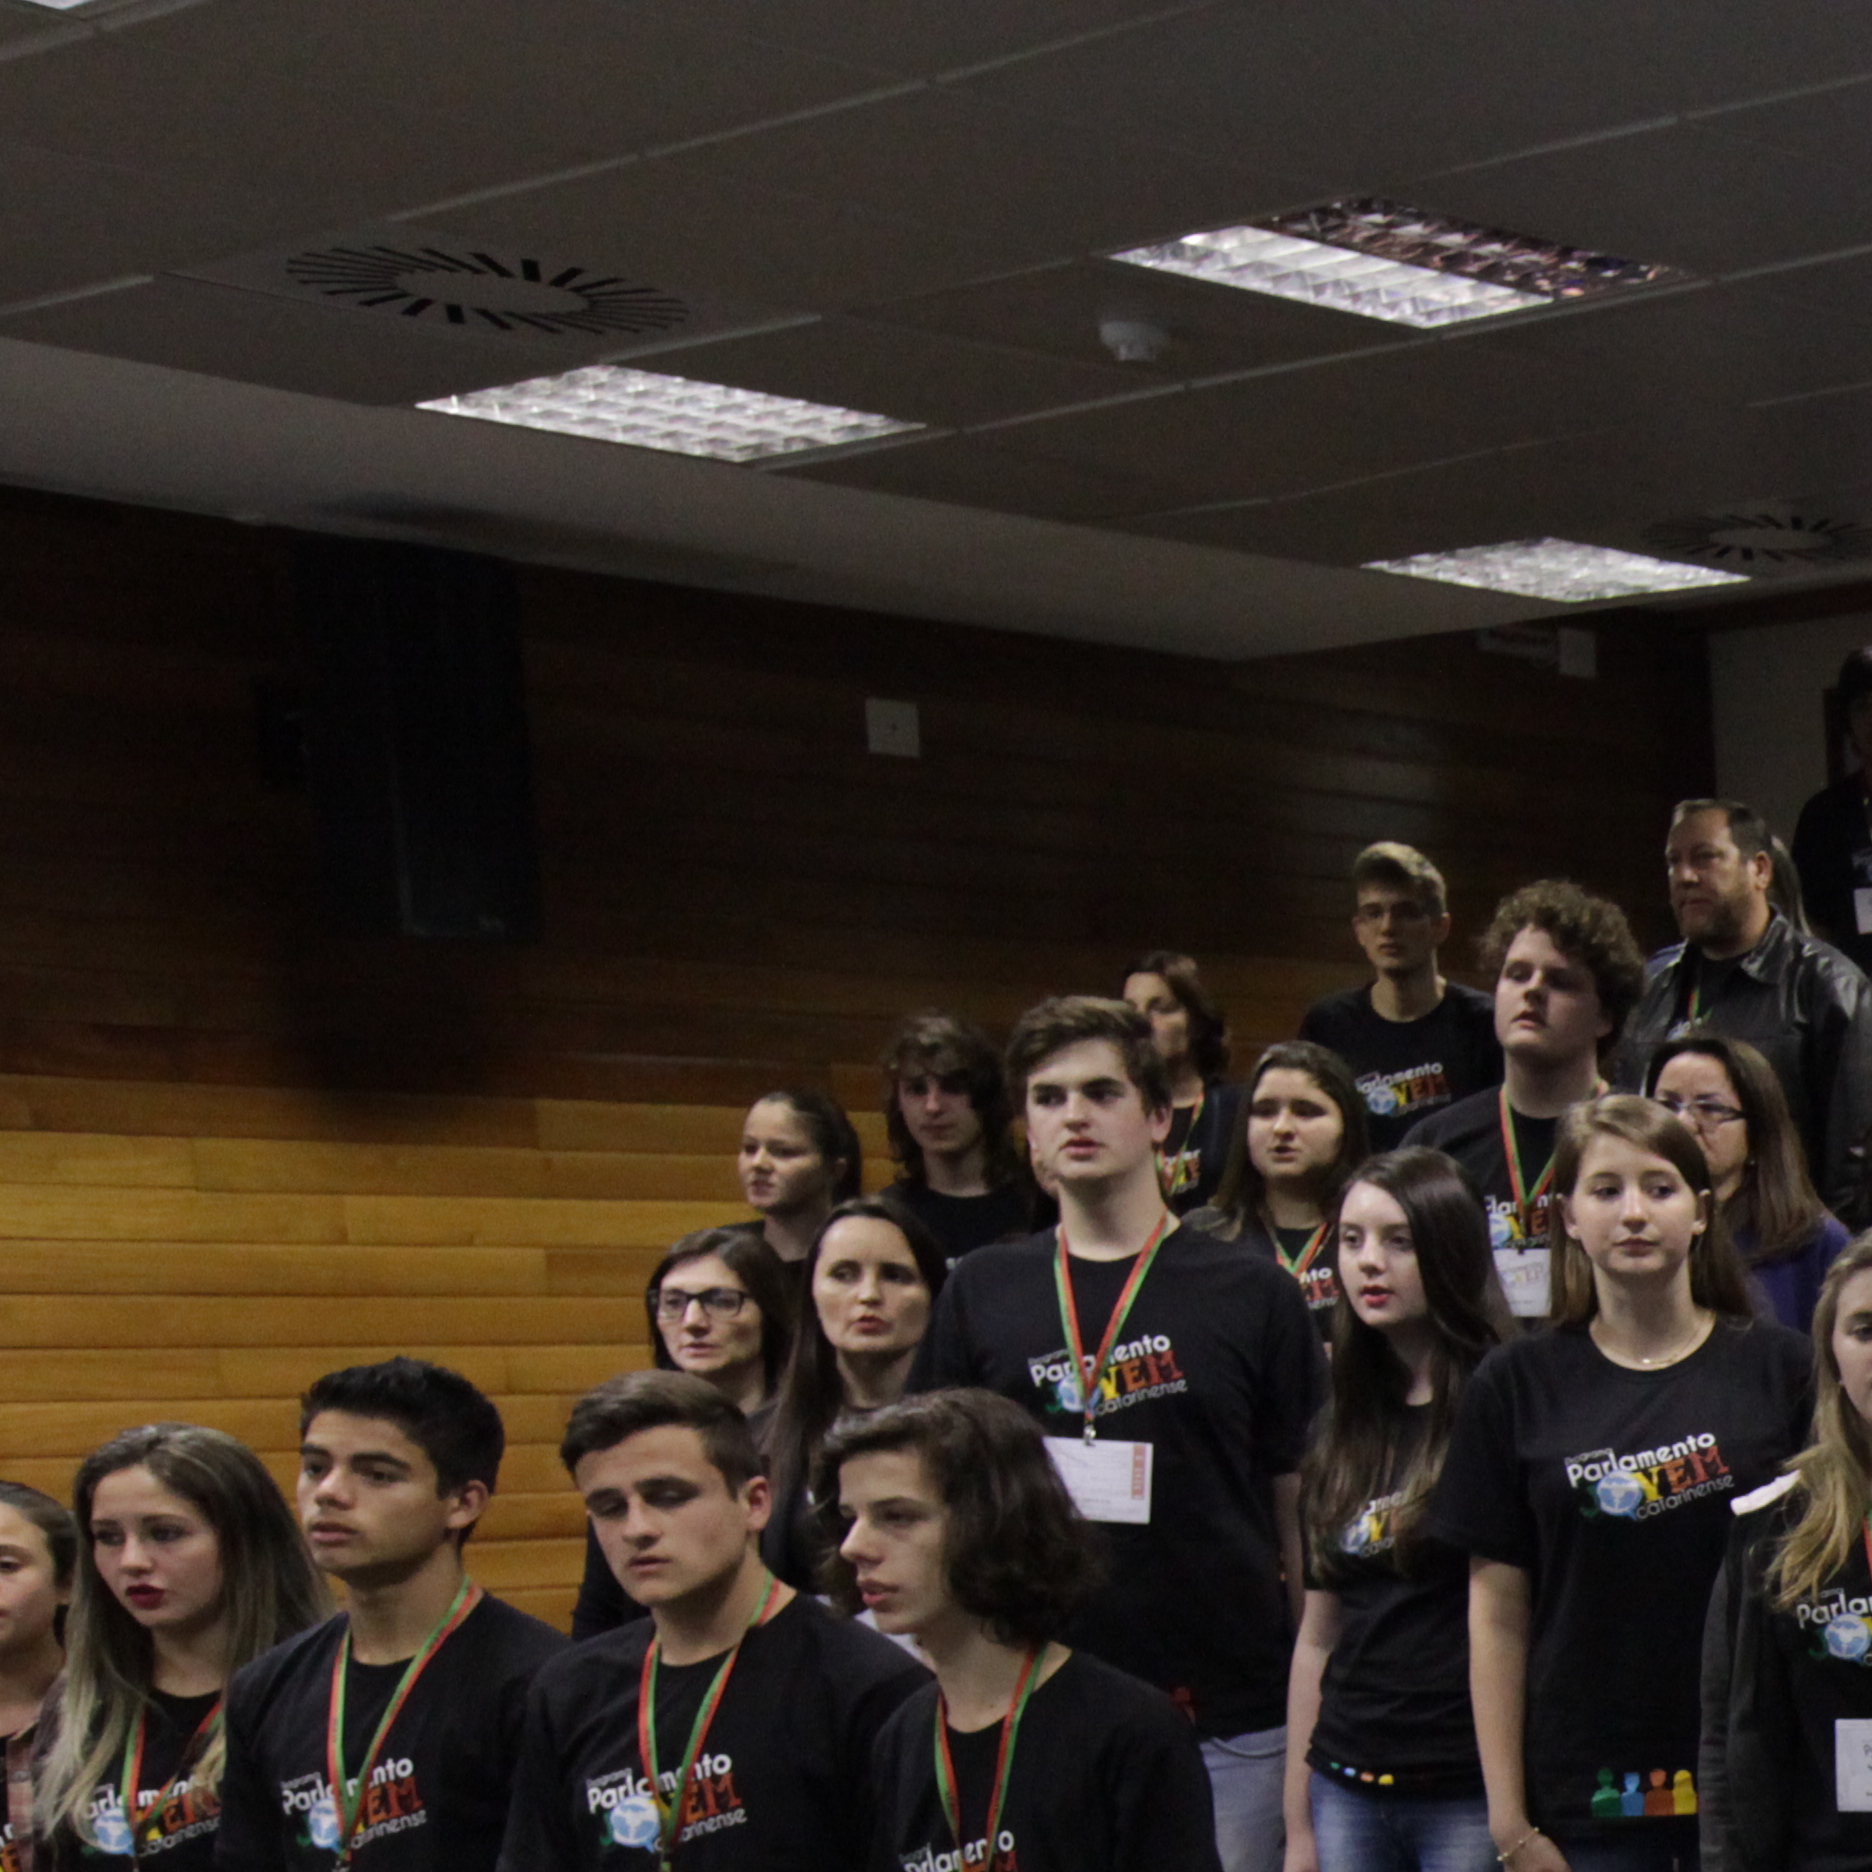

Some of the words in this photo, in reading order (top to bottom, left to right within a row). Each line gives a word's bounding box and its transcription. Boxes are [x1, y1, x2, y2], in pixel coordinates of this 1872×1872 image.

[1566, 1432, 1717, 1489] Parlamento
[1579, 1446, 1730, 1518] JOVEM
[1636, 1475, 1735, 1521] catarinense
